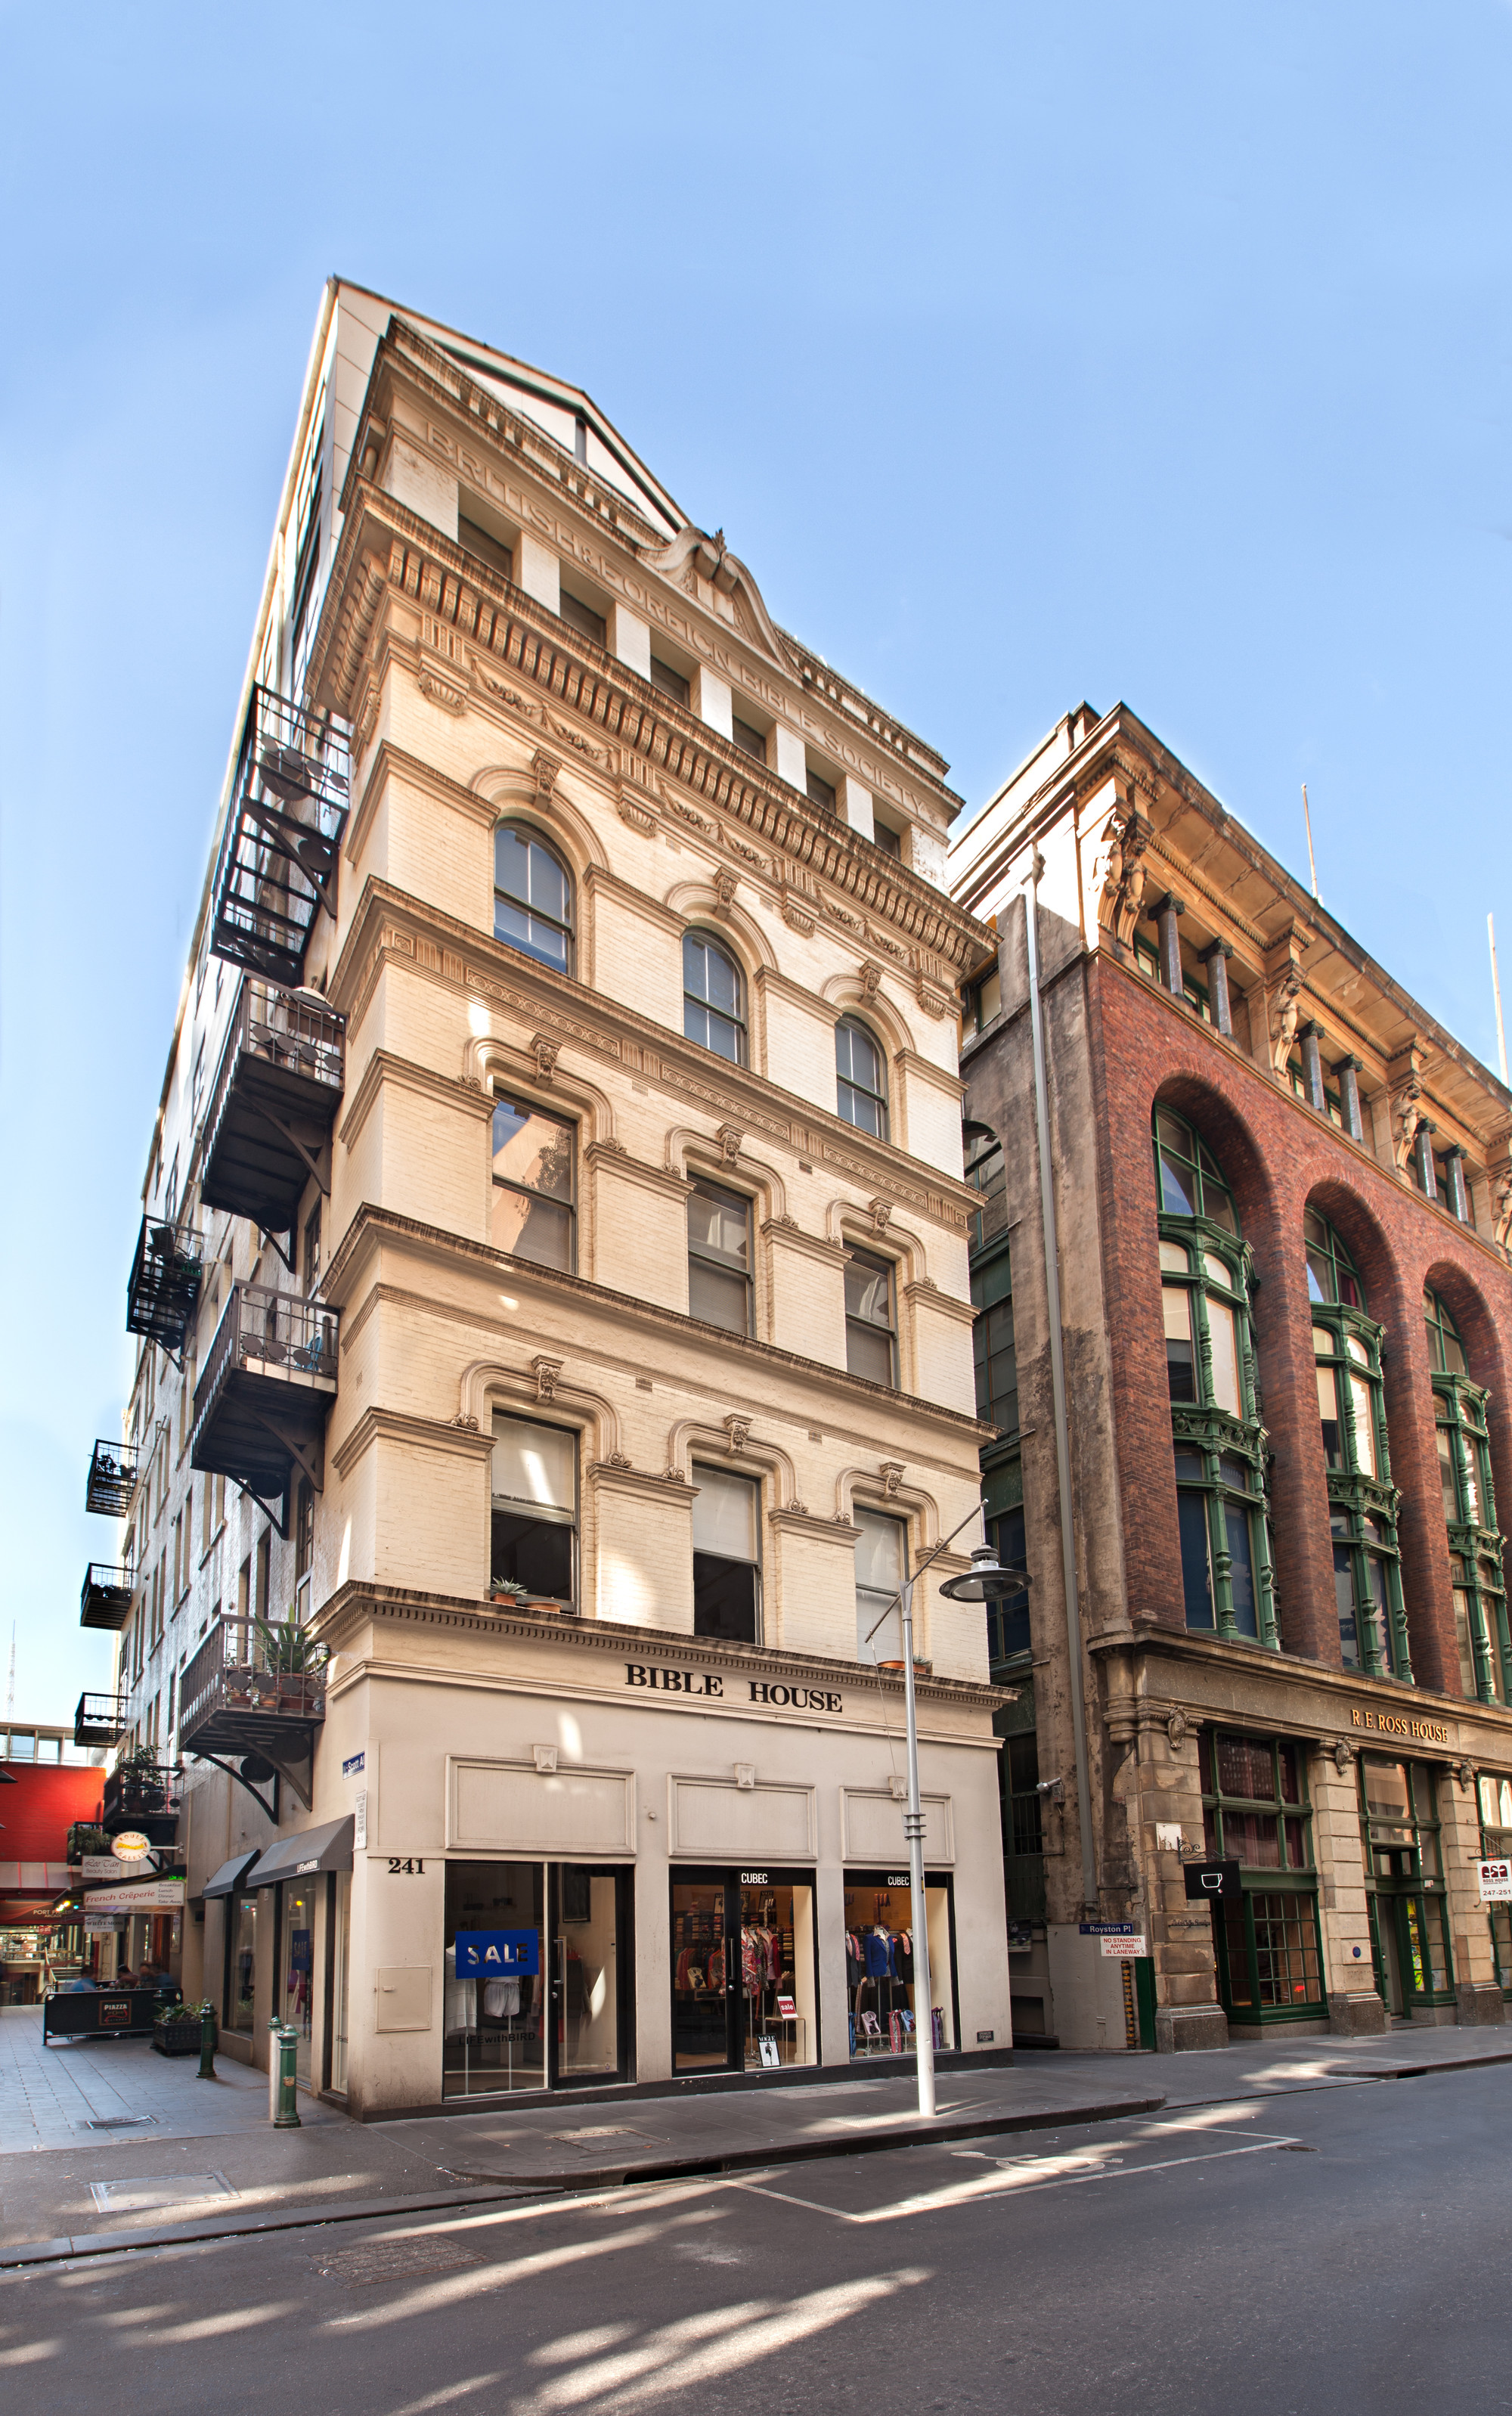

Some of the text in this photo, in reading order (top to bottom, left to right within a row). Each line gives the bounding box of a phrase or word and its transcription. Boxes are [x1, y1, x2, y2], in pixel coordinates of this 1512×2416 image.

[624, 1664, 843, 1713] BIBLE HOUSE
[1365, 1711, 1376, 1729] E.
[1377, 1714, 1408, 1735] ROSS
[1411, 1721, 1448, 1742] HOUSE
[348, 1759, 359, 1770] Scott
[388, 1858, 426, 1874] 241
[741, 1872, 768, 1884] CUBEC
[888, 1876, 909, 1886] CUBEC
[85, 1890, 155, 1903] French Crêperie
[1089, 1925, 1120, 1934] Royston
[467, 1943, 528, 1965] SALE
[458, 2032, 535, 2045] LIFEwithBIRD
